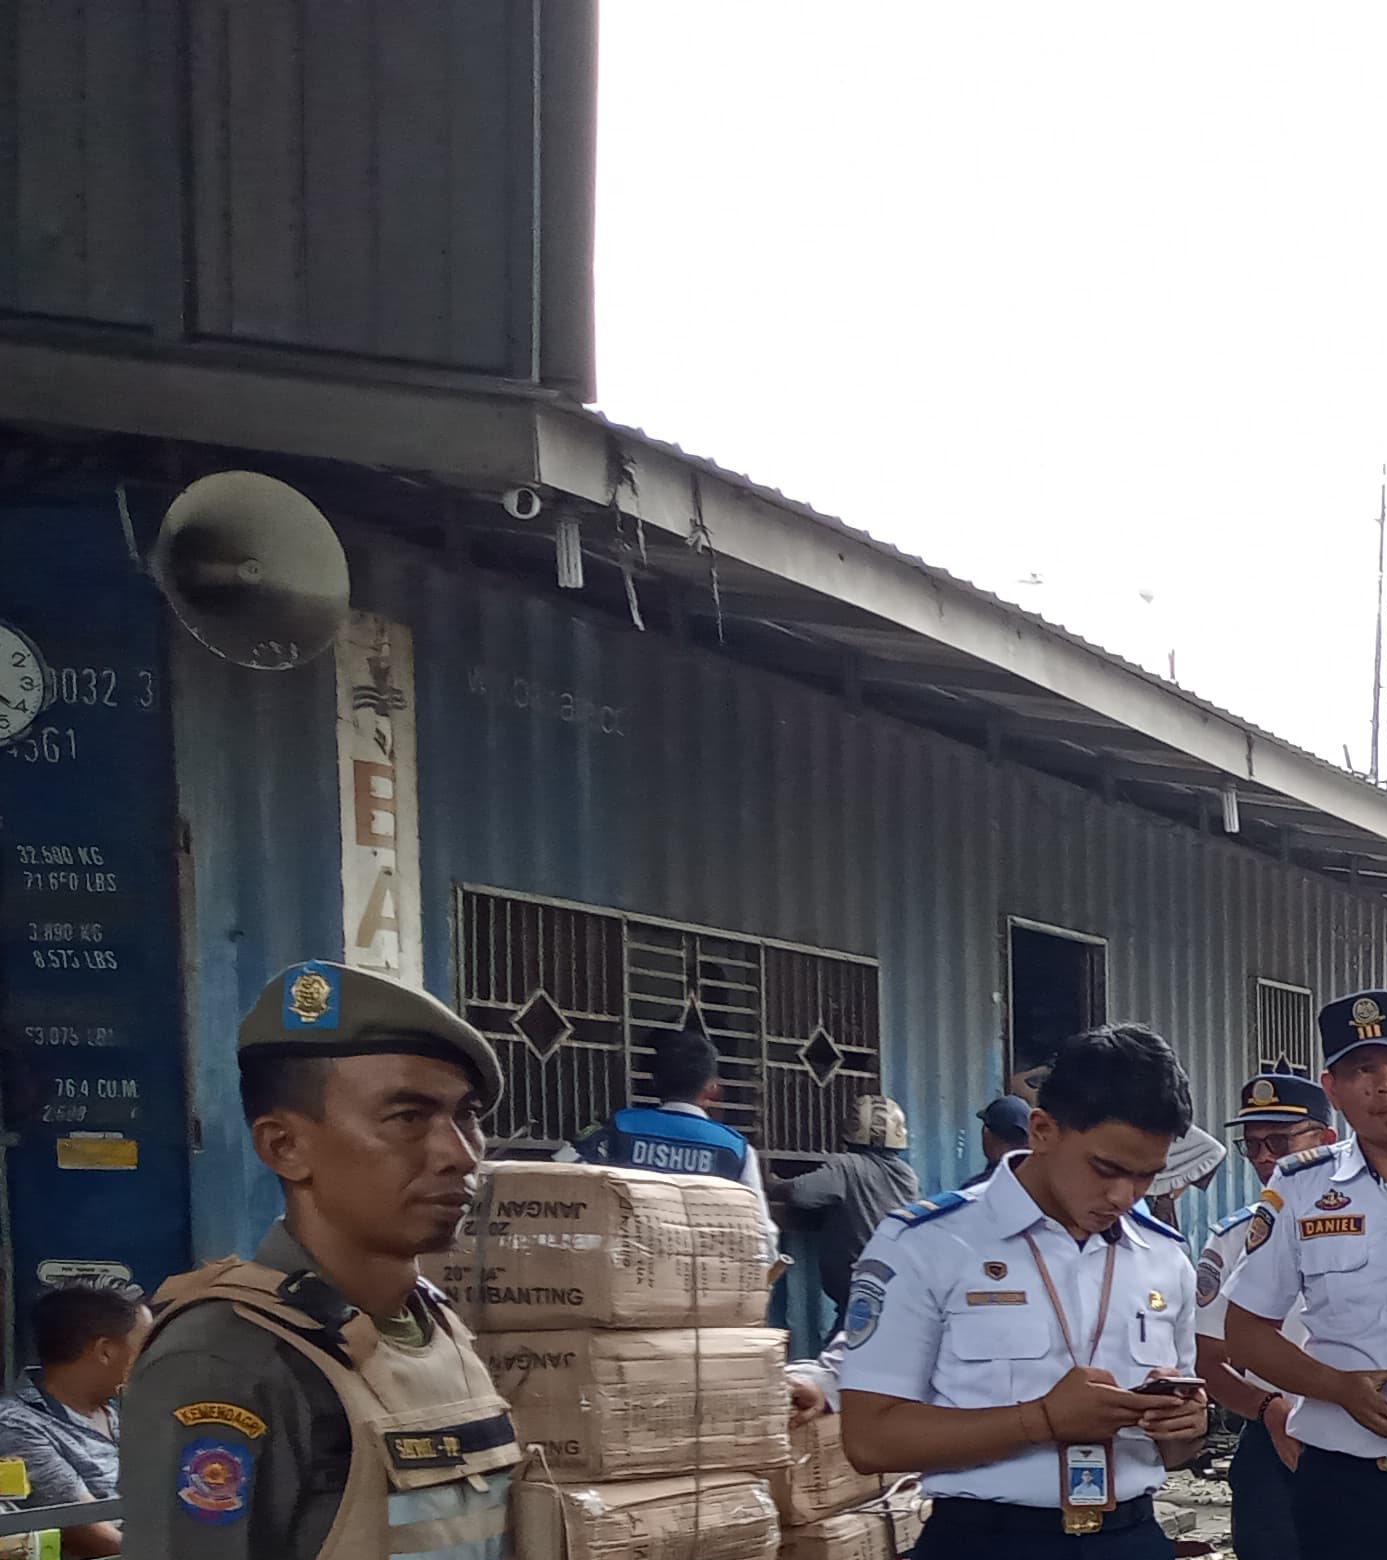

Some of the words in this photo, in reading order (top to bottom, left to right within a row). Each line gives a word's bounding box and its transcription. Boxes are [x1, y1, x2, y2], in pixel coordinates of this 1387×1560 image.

[138, 671, 153, 708] 3
[78, 846, 104, 866] KG
[86, 873, 117, 892] LBS
[83, 950, 118, 969] LBS
[632, 1140, 713, 1173] DISHUB
[497, 1201, 587, 1220] JANGAN
[1304, 1218, 1358, 1235] DANIEL
